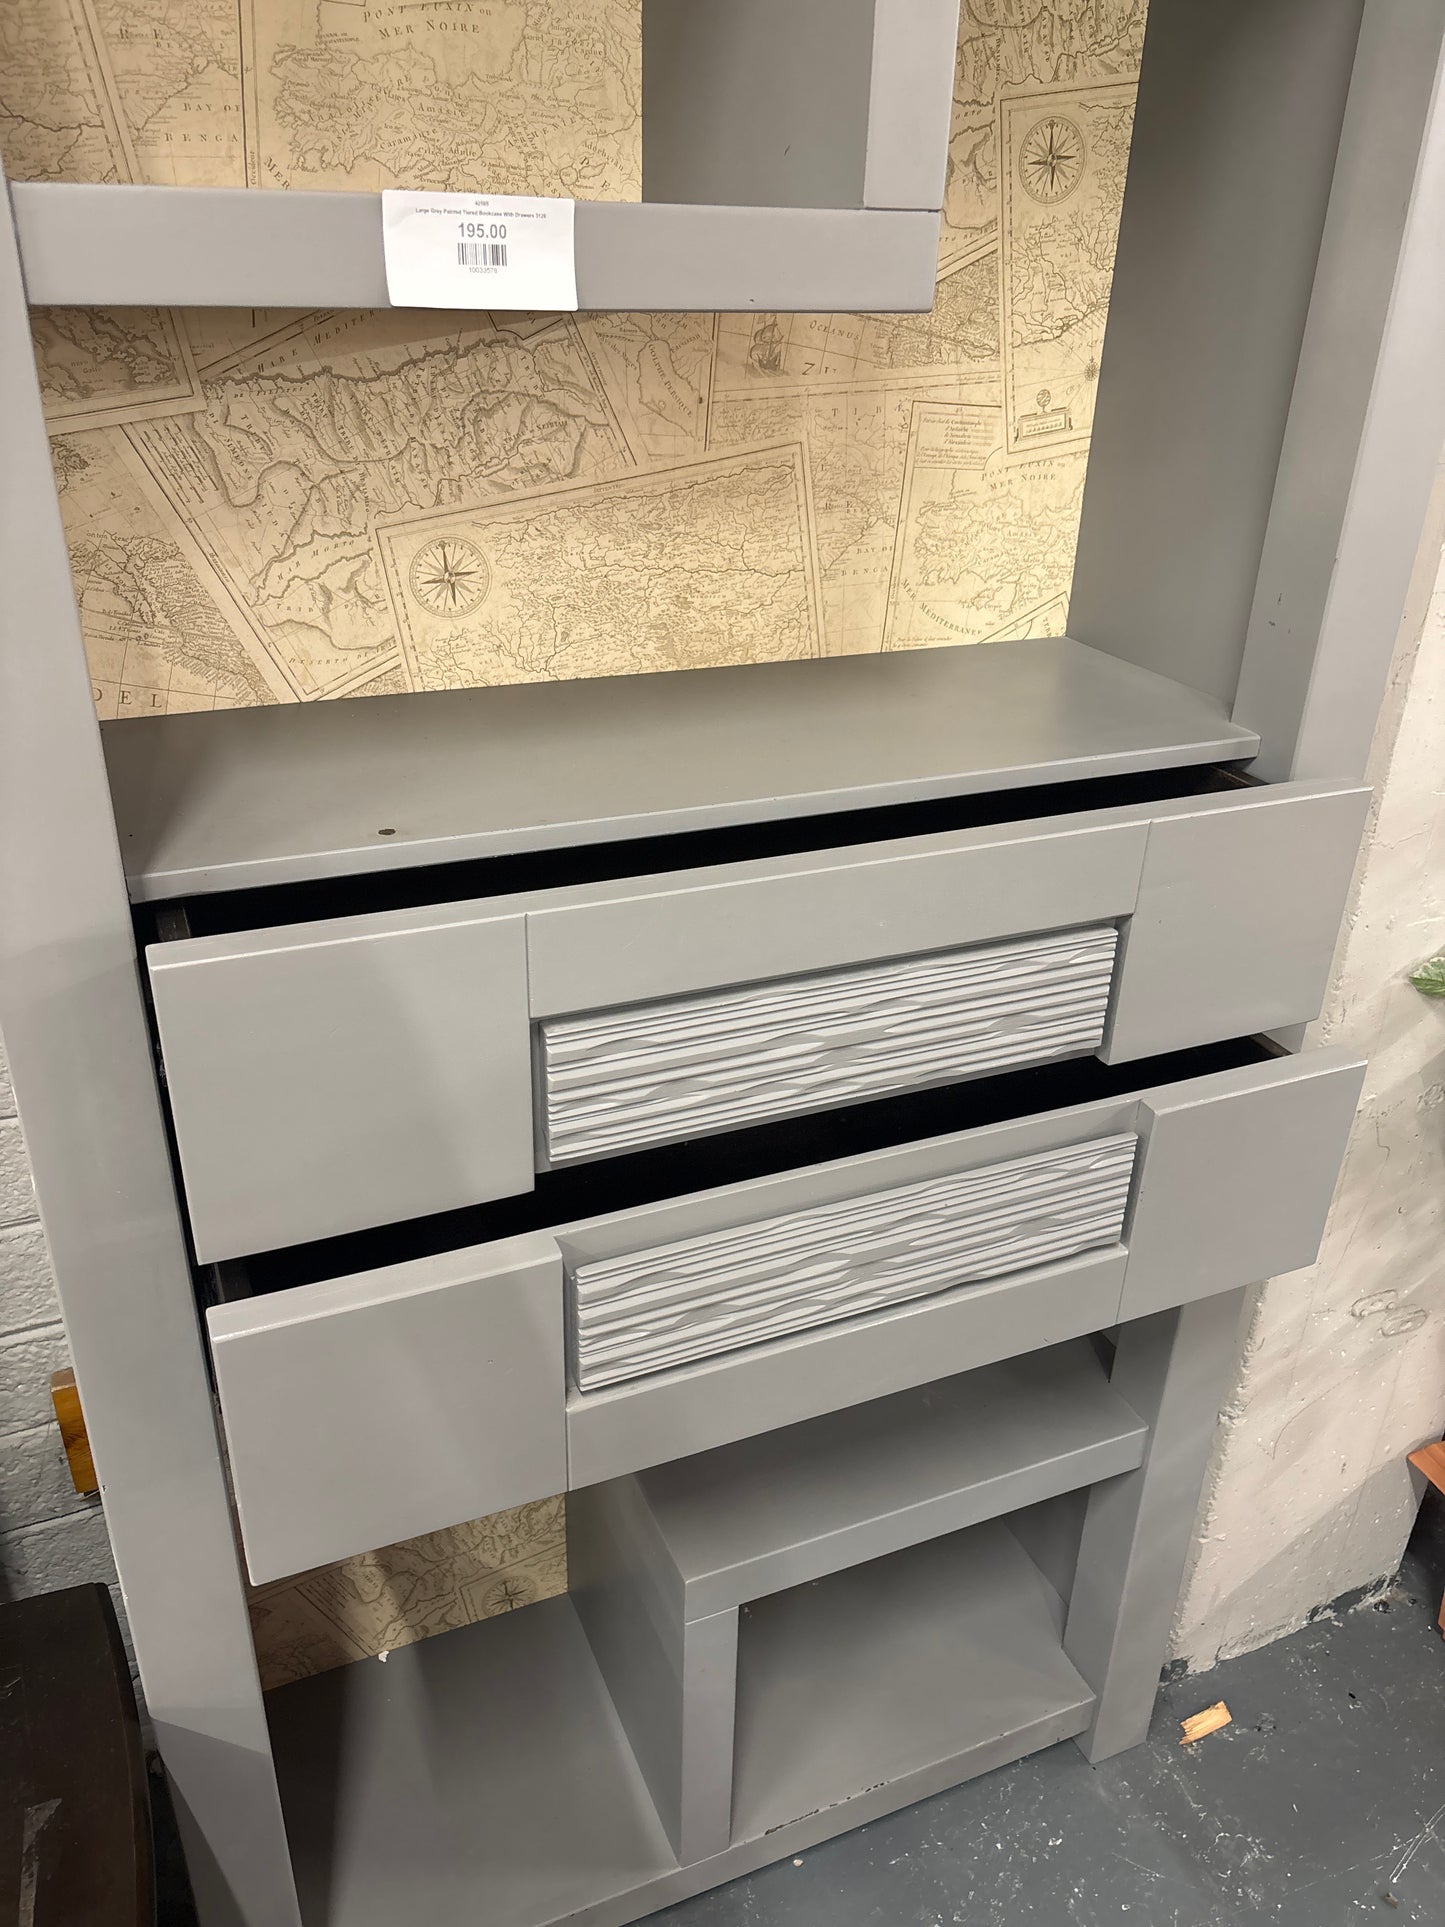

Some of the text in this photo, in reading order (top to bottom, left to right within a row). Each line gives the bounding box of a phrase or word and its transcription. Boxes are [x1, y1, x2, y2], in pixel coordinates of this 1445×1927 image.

[378, 19, 480, 40] MER NOIRE
[184, 103, 213, 112] BAY
[458, 222, 507, 239] 195.00
[809, 319, 860, 341] OCEANUS
[1021, 473, 1056, 481] NOIRE
[901, 578, 916, 600] MER
